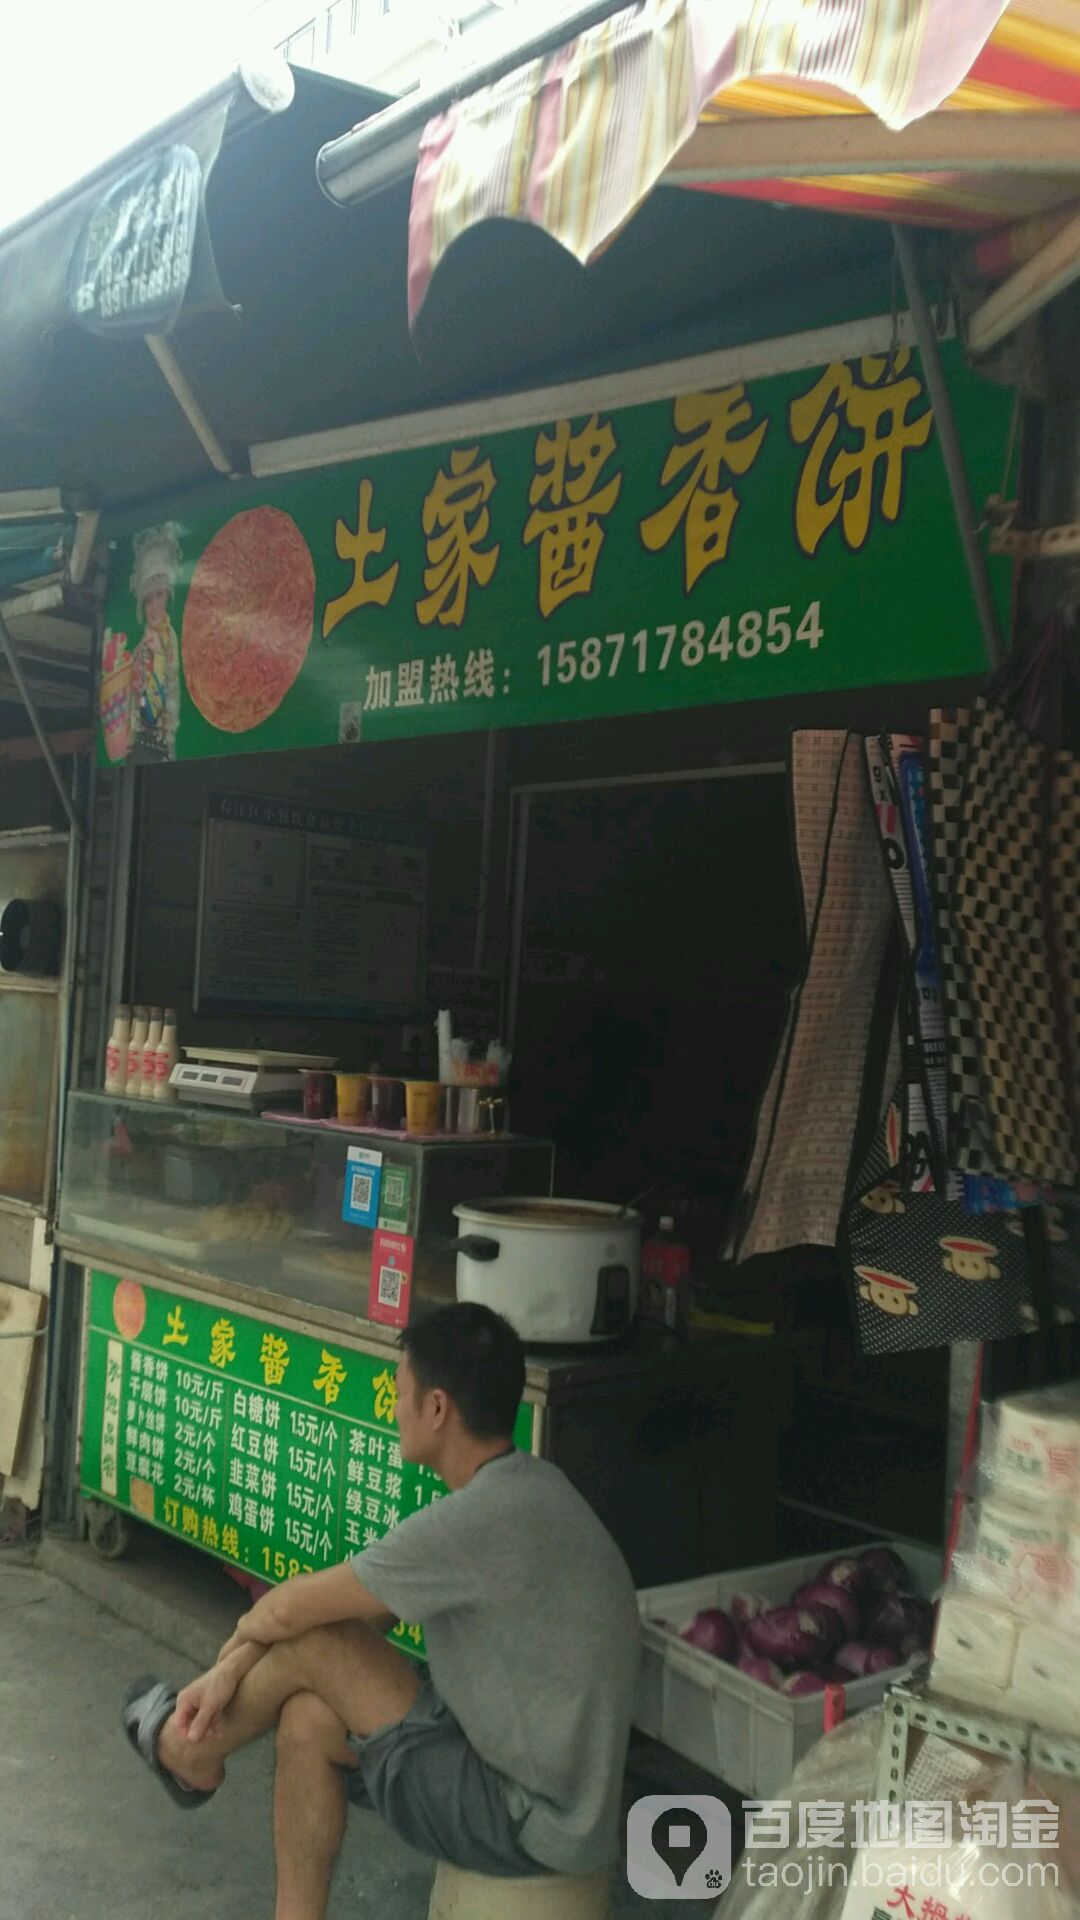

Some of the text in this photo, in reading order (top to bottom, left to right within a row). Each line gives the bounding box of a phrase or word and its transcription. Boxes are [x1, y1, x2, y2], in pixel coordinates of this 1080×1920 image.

[536, 600, 825, 686] 15871784854
[176, 1369, 224, 1404] 10元/斤
[174, 1395, 223, 1430] 10元/斤
[233, 1388, 280, 1430] 白糖饼
[125, 1425, 216, 1482] 鲜肉饼 2元/个
[174, 1421, 216, 1455] 2元/个
[230, 1421, 279, 1466] 红豆饼
[349, 1428, 403, 1470] 茶叶蛋
[174, 1474, 216, 1509] 2元/杯
[229, 1457, 277, 1501] 韭菜饼
[347, 1458, 402, 1499] 鲜豆浆
[228, 1492, 275, 1537] 鸡蛋饼
